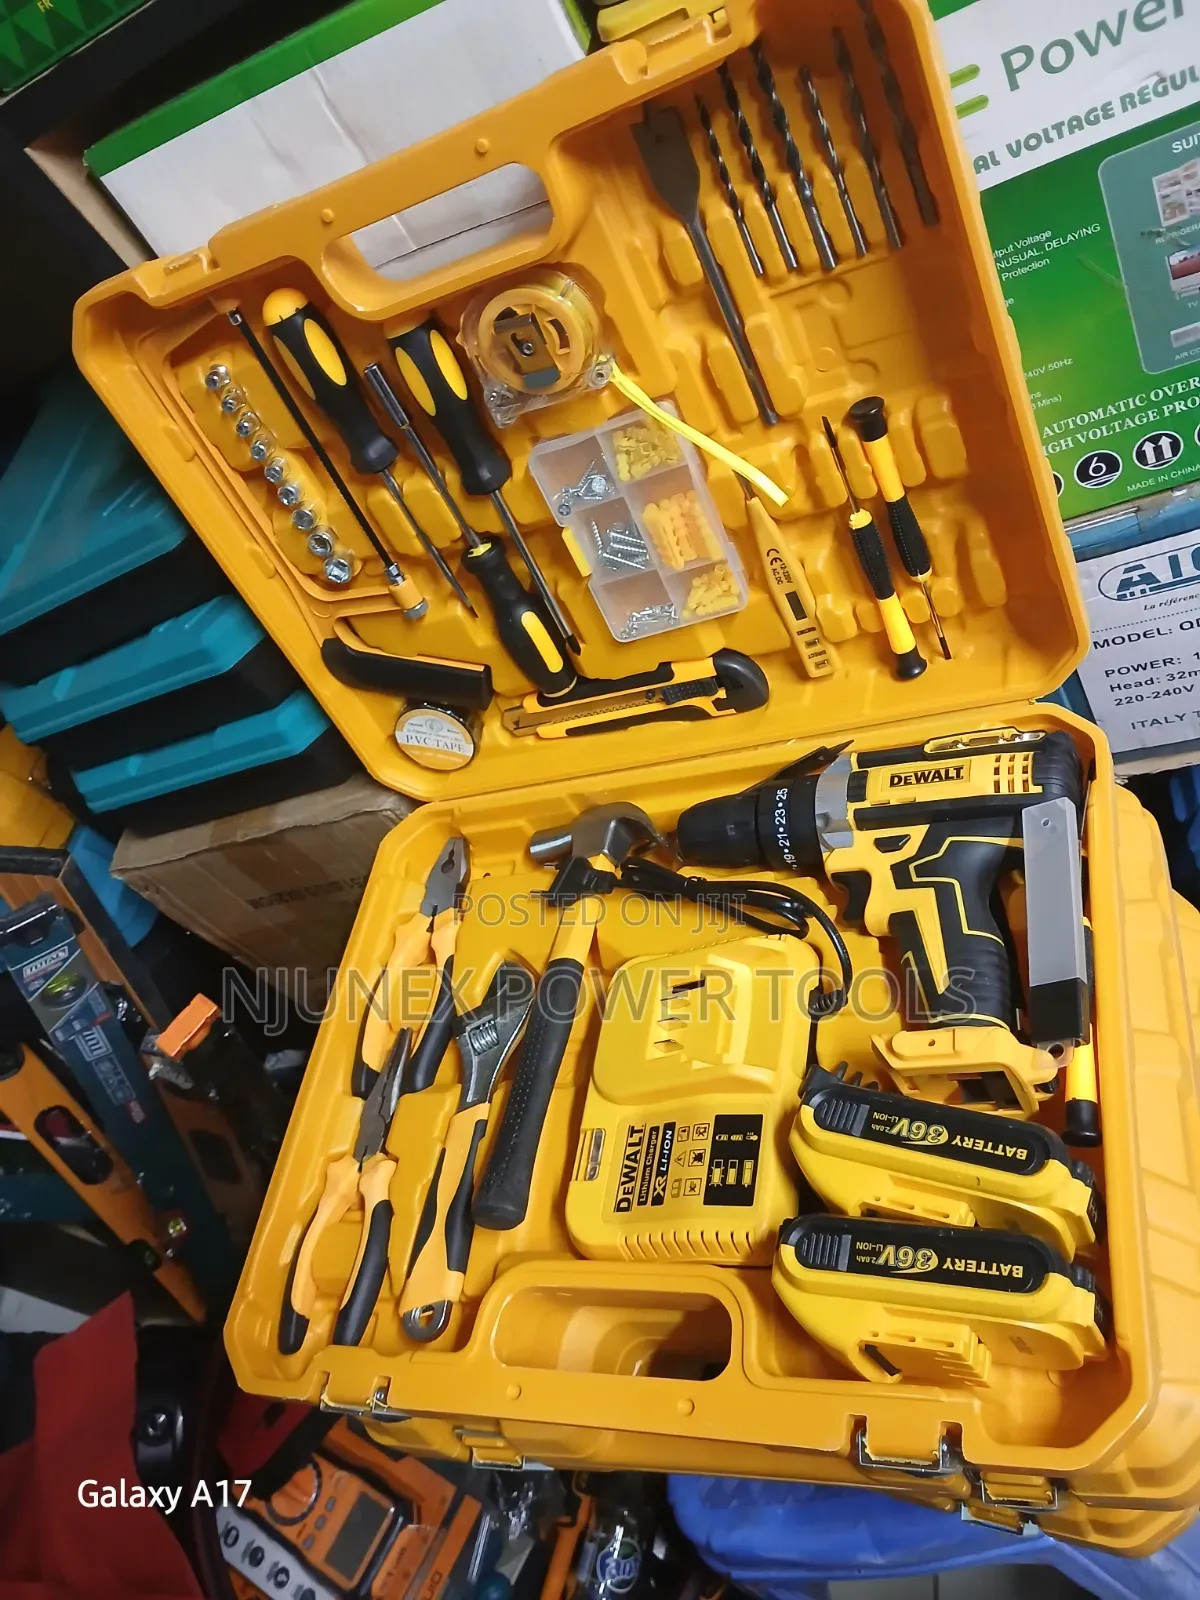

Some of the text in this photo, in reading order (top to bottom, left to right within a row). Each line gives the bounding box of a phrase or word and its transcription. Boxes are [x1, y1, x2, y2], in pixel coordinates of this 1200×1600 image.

[1006, 101, 1116, 158] VOLTAGE
[1119, 65, 1200, 113] REGUL
[1172, 132, 1200, 153] SUI
[1014, 230, 1052, 249] Voltage
[1044, 223, 1101, 251] DELAYING
[1001, 257, 1050, 281] Protection
[1048, 358, 1073, 371] 50Hz
[1042, 376, 1200, 439] AUTOMATIC OVER
[1076, 408, 1160, 444] VOLTAGE
[1162, 395, 1200, 418] PRO
[1127, 463, 1200, 492] MADE IN CHINA
[1093, 627, 1173, 650] MODEL:
[1104, 656, 1182, 678] POWER:
[1109, 674, 1161, 692] Head:
[1114, 684, 1195, 706] 220-240V
[1131, 712, 1187, 730] ITALY
[890, 765, 964, 788] DEWALT
[873, 1111, 1028, 1160] BATTERY 36V LI-ION
[660, 1130, 673, 1172] LI-ION
[615, 1124, 645, 1213] DEWALT
[639, 1130, 657, 1202] Lithium Charger
[856, 1242, 1024, 1278] BATTERY 36V LI-ION
